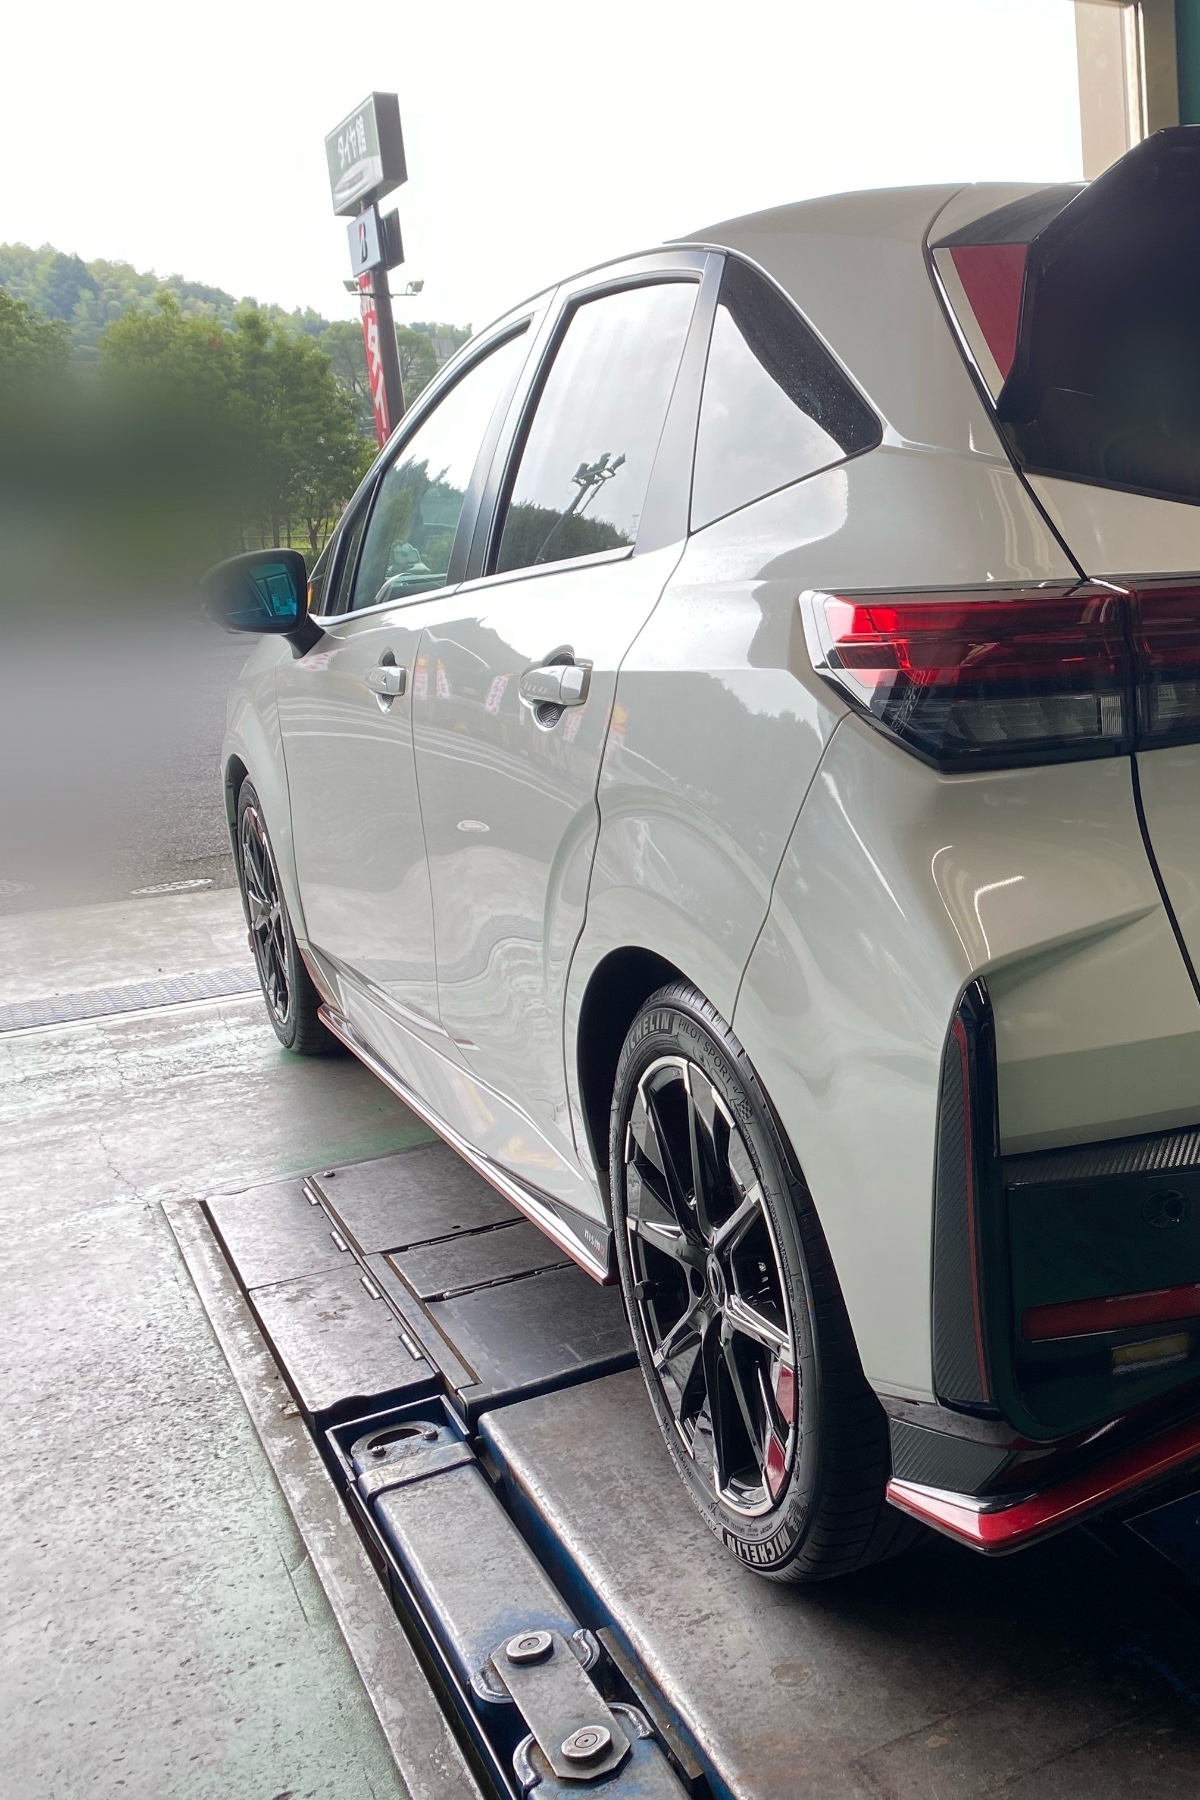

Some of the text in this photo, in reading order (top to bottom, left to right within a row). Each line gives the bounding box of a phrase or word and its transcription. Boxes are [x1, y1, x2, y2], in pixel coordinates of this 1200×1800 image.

[337, 114, 367, 170] タイヤ館
[616, 1011, 671, 1076] MICHELIN
[678, 1017, 704, 1044] PILOT
[703, 1041, 735, 1084] SPORT
[726, 1525, 791, 1564] MICHELIN
